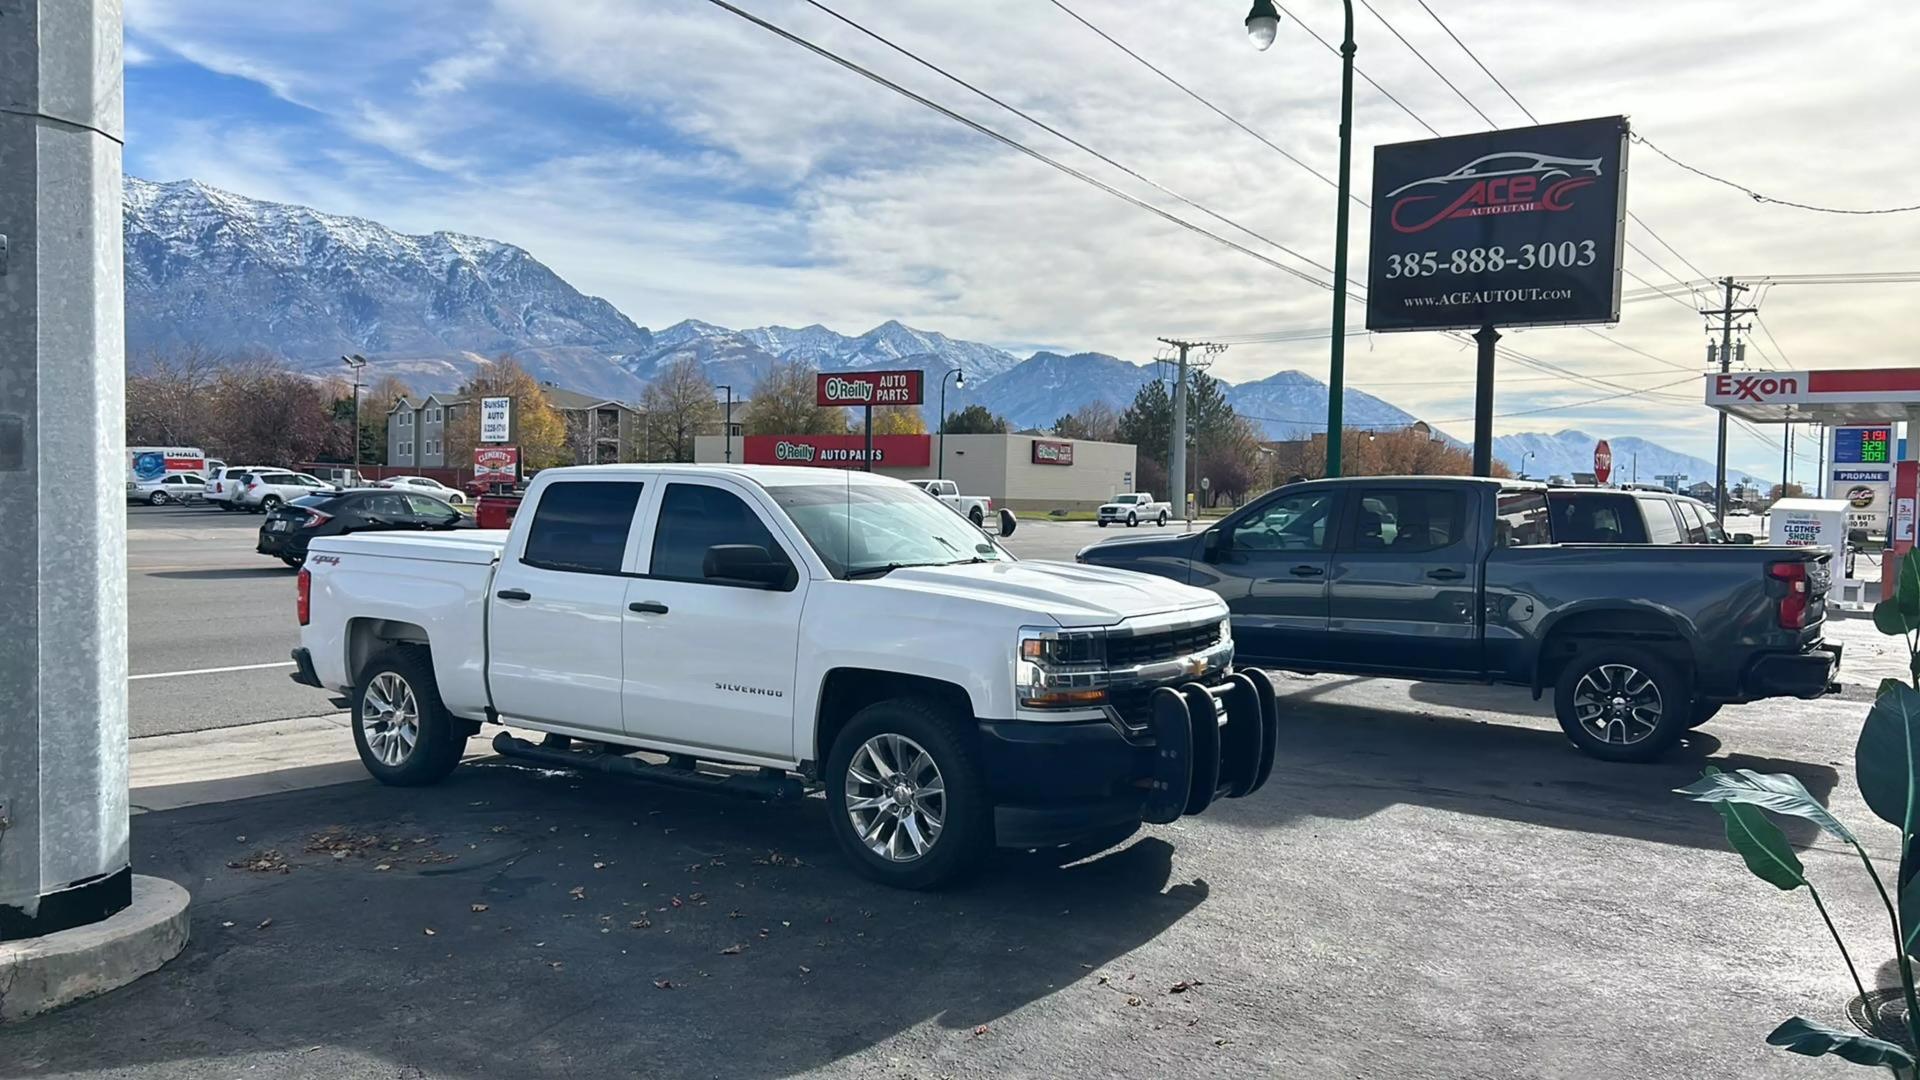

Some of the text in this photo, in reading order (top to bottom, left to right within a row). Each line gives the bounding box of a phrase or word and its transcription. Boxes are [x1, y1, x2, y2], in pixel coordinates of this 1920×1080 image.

[1469, 202, 1535, 216] AUTO UTAH
[1385, 239, 1597, 279] 385-888-3003
[826, 375, 907, 401] O'Reilly AUTO
[1716, 375, 1797, 402] Exxon
[876, 389, 909, 401] PARTS
[484, 400, 508, 408] SUNSET
[488, 411, 504, 420] AUTO
[776, 441, 815, 461] O'Reilly
[820, 449, 847, 460] AUTO
[1596, 453, 1610, 470] STOP
[1840, 472, 1883, 480] PROPANE
[1784, 525, 1821, 533] CLOTHES
[1788, 533, 1816, 541] SHOES
